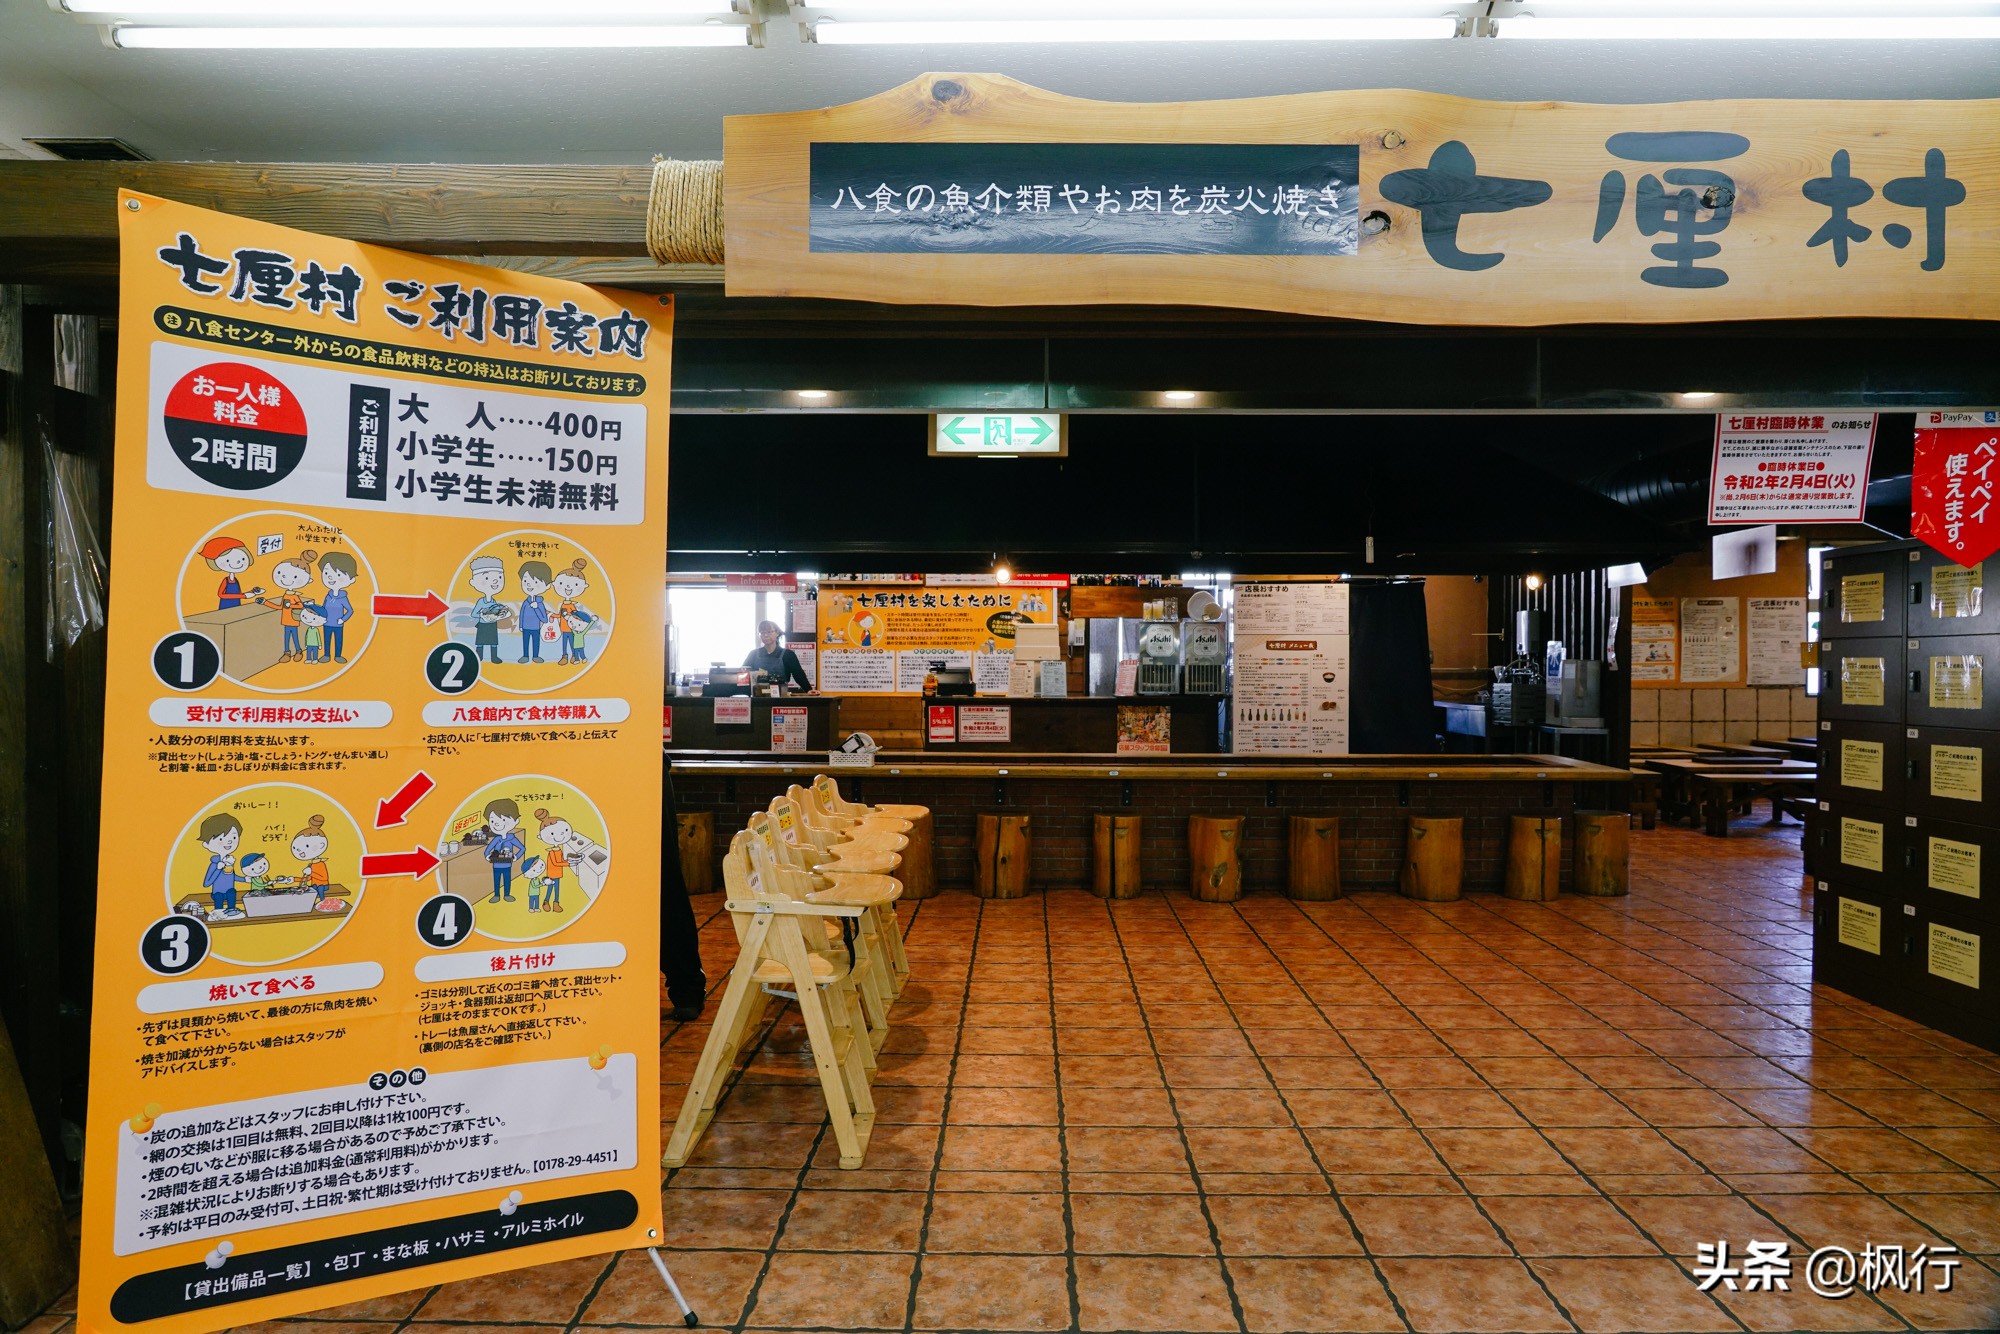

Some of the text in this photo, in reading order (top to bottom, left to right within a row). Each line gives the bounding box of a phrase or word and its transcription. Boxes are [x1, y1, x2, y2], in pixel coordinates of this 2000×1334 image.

[830, 183, 1342, 216] 八食の魚介類やお肉を炭火焼き
[1378, 131, 1967, 289] 七厘村
[158, 233, 649, 359] 七厘村 ご利用案内
[186, 314, 643, 395] 八食センター外からの食品飲料などの持込はお断りしております。
[192, 374, 281, 409] お一人様
[213, 400, 258, 426] 料金
[1729, 416, 1871, 430] 七厘村臨時休業 のお知らせ
[1943, 413, 1973, 422] PayPay
[358, 399, 378, 489] ご利用料金
[191, 437, 277, 473] 2時間
[395, 468, 618, 512] 小学生未満無料
[1724, 474, 1855, 490] 令和2年2月4日(火)
[1971, 437, 1997, 523] ペイペイ
[1945, 453, 1968, 550] 使えます。
[296, 534, 342, 544] 小学生です!
[298, 524, 342, 534] 大人ふたりと
[259, 537, 282, 554] 受付
[508, 540, 559, 549] 七厘村で焼いて
[518, 549, 547, 558] 食べます!
[857, 593, 1012, 608] 七厘村を楽しむために
[1150, 635, 1171, 643] Asahi
[1196, 635, 1217, 643] Asahi
[173, 642, 195, 683] 1
[441, 650, 465, 687] 2
[187, 705, 359, 723] 受付で利用料の支払い
[452, 705, 601, 721] 八食館内で食材等購入
[427, 746, 461, 756] 下さい。
[262, 834, 288, 842] どうぞ!
[265, 824, 286, 832] ハイ!
[432, 904, 458, 941] 4
[160, 924, 190, 968] 3
[490, 952, 556, 972] 後片付け
[209, 975, 316, 1002] 焼いて食べる
[420, 988, 603, 1012] ジョッキ・食器類は返却口へ戻して下さい。
[144, 1028, 231, 1046] て食べて下さい。
[419, 1030, 552, 1054] (裏側の店名をご確認下さい。)
[142, 1056, 236, 1078] アドバイスします。
[374, 1072, 423, 1087] その他
